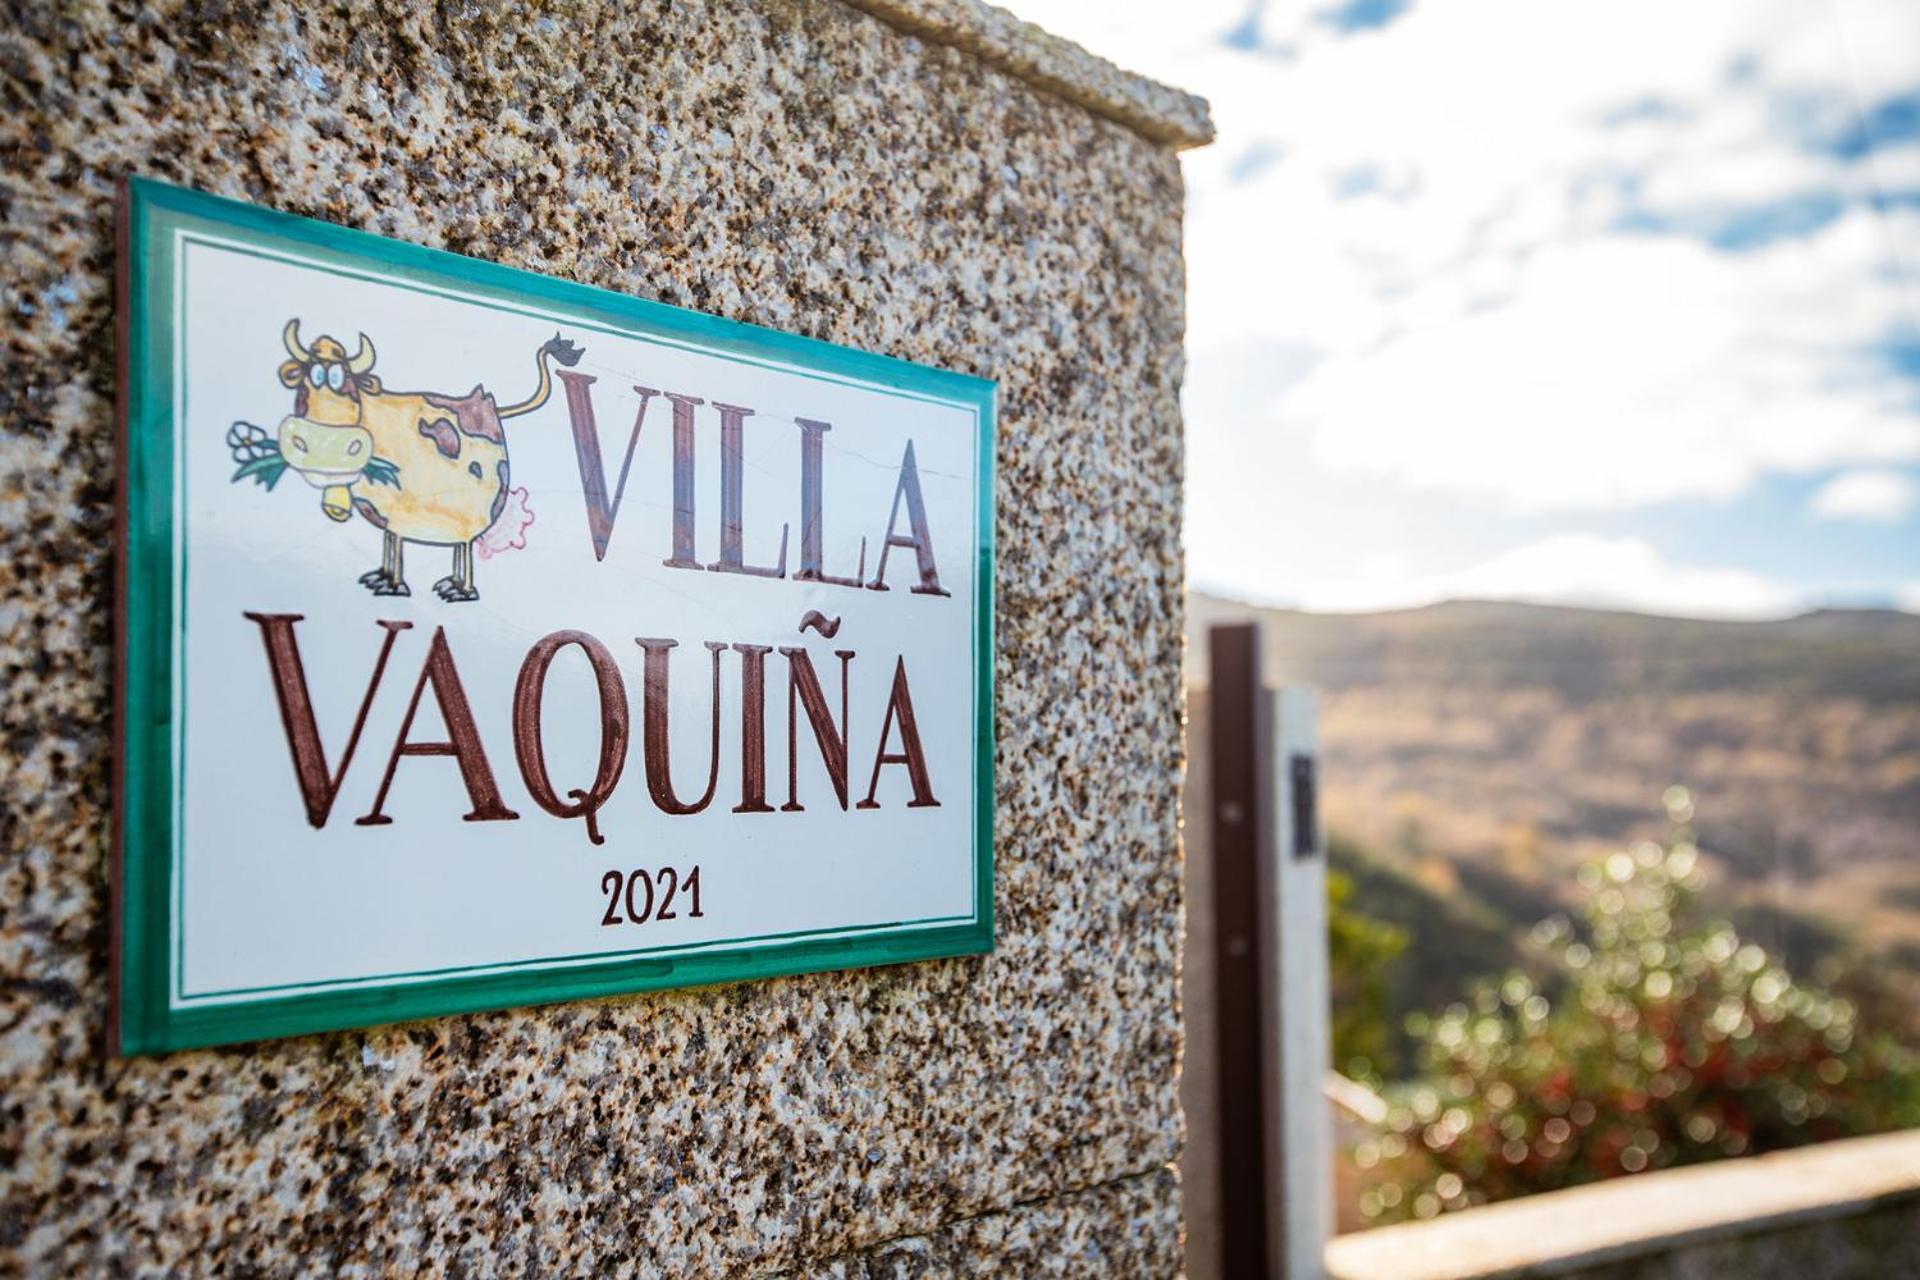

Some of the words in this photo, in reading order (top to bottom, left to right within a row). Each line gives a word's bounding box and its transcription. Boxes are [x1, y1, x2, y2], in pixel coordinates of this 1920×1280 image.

[556, 369, 951, 598] VILLA
[243, 609, 941, 845] VAQUIÑA
[601, 866, 704, 926] 2021
